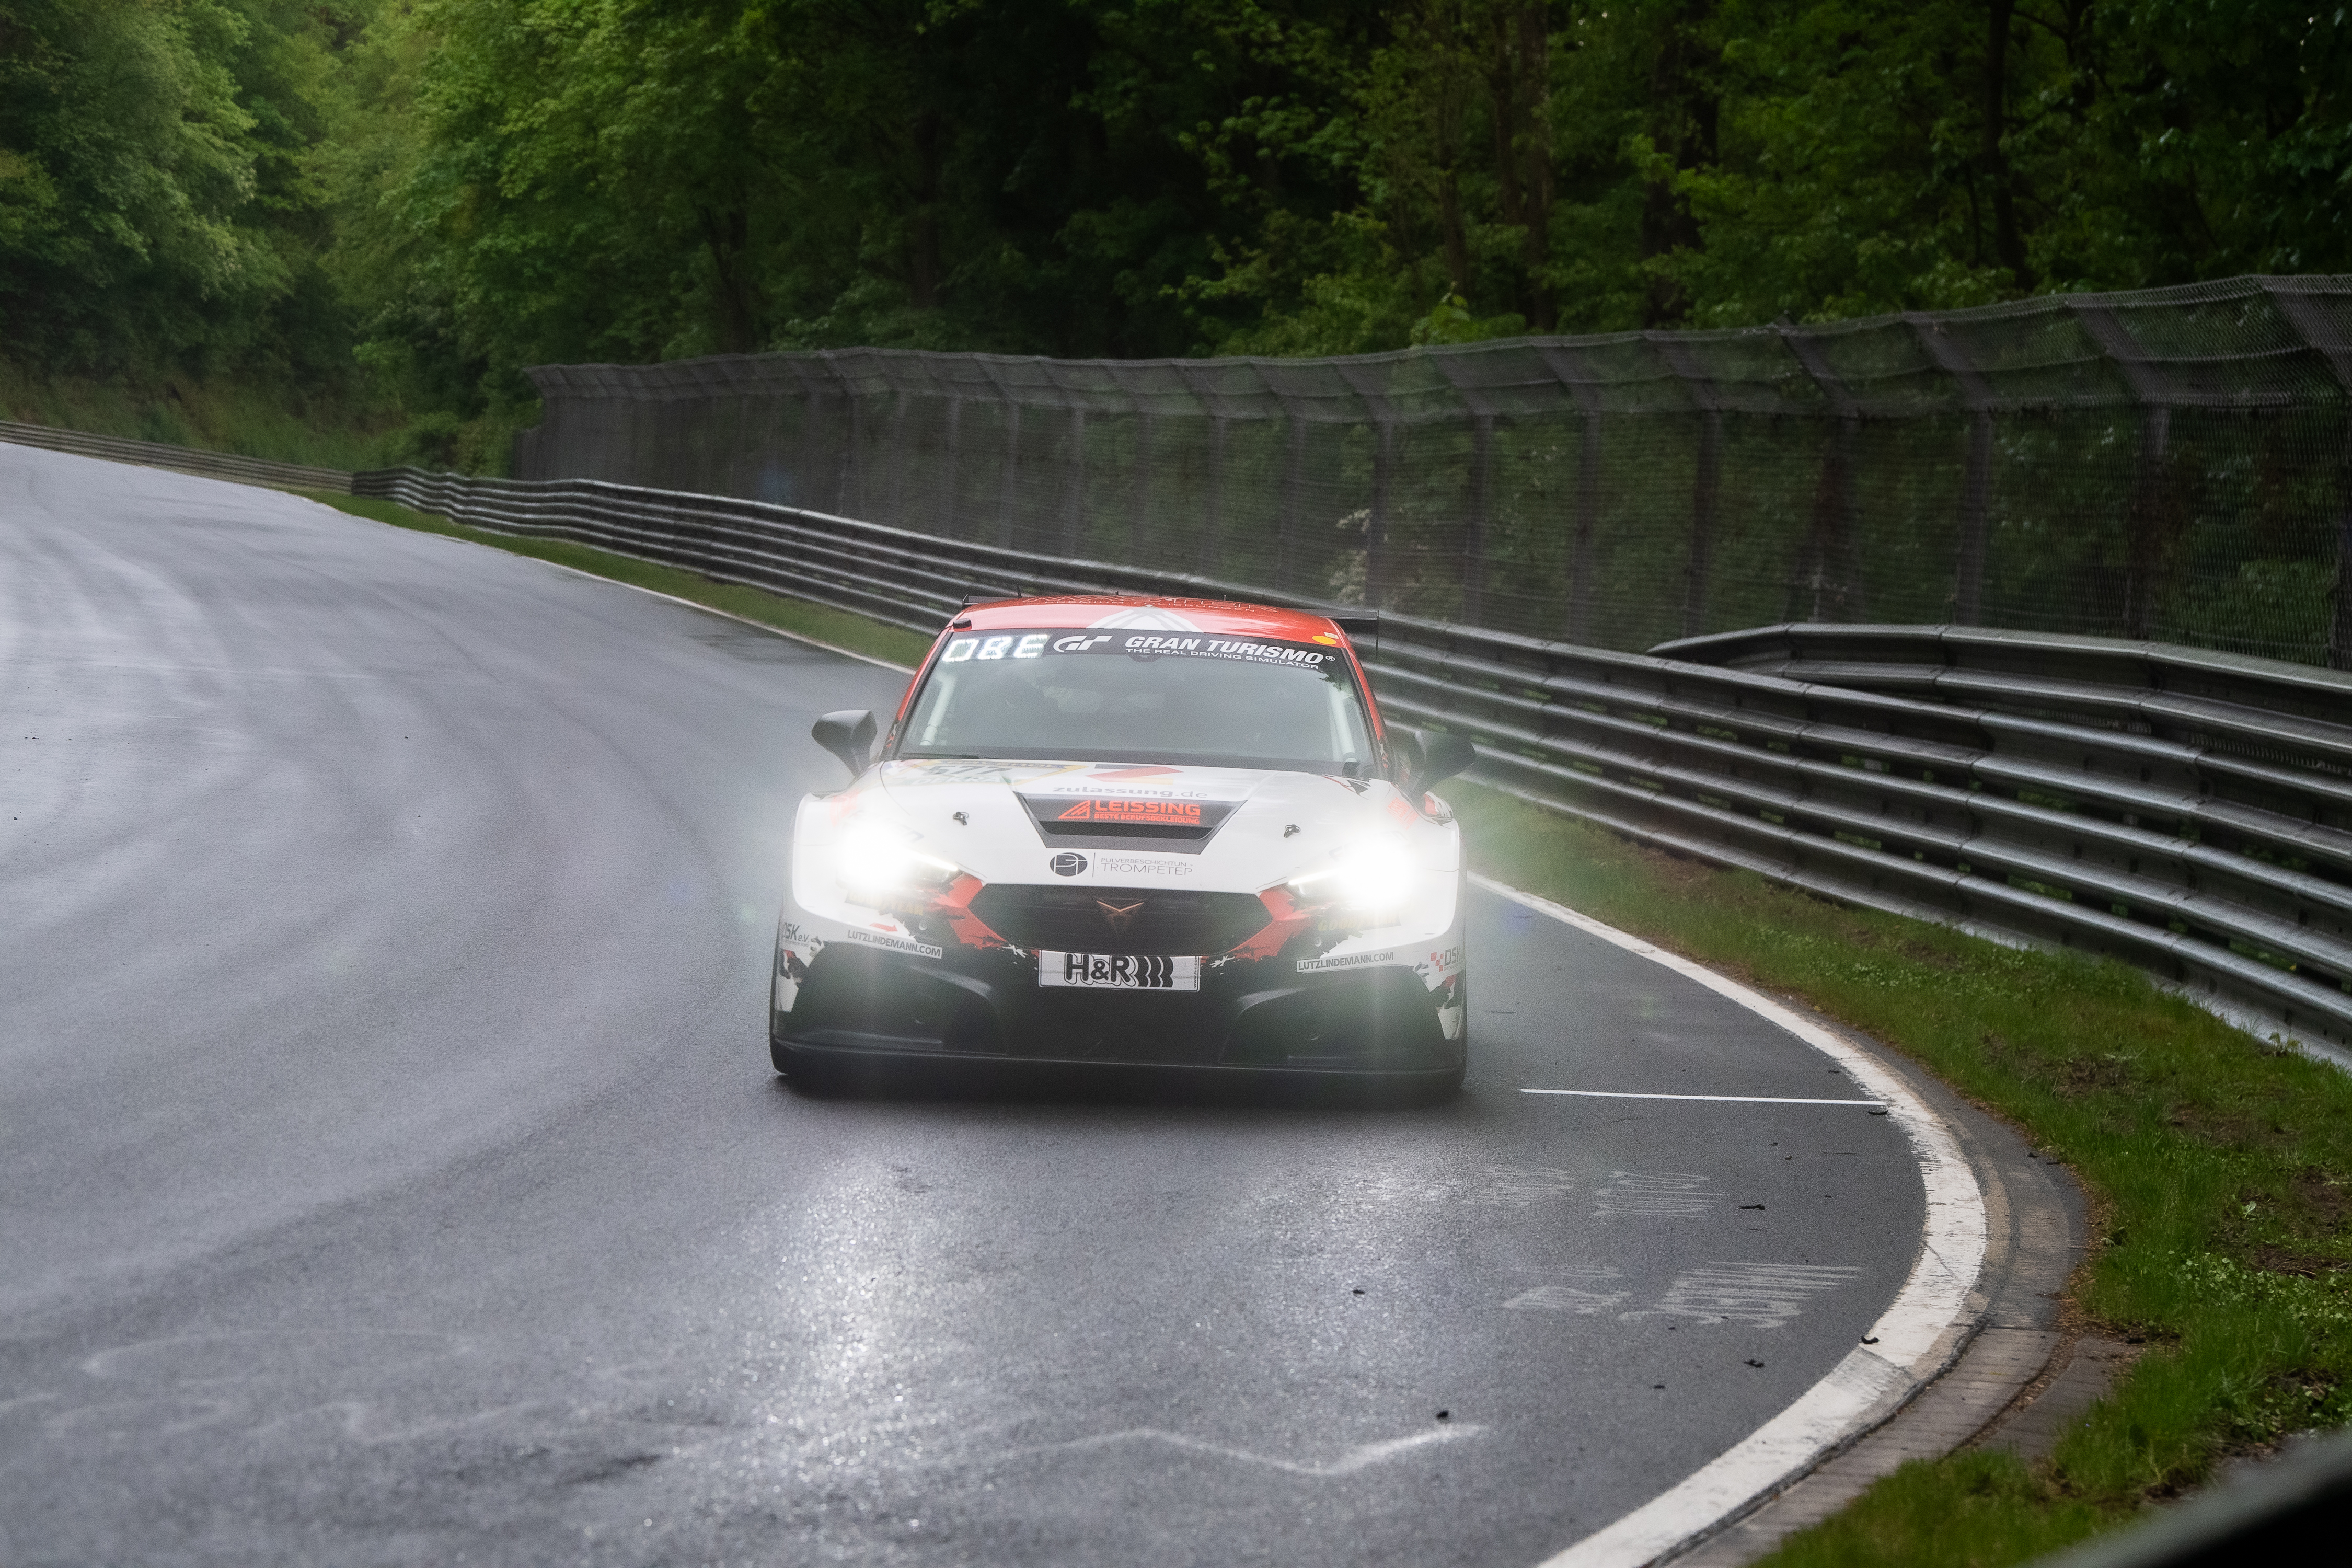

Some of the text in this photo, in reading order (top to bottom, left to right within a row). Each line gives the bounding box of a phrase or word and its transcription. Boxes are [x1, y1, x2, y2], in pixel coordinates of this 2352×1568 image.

[1125, 636, 1323, 664] GRAN TURISMO
[1190, 651, 1242, 660] DRIVING
[1245, 655, 1319, 670] SIMULATOR
[1053, 786, 1208, 799] zulassung.de
[1094, 800, 1201, 816] LEISSING
[1120, 814, 1201, 825] BERUFSBEKLEIDUNG
[1101, 858, 1193, 867] PULVERBESCHICHTUN
[848, 930, 940, 957] LUTZLINDEMANN.COM
[1064, 952, 1136, 987] H&R
[1298, 952, 1394, 971] LUTZLINDEMANN.COM
